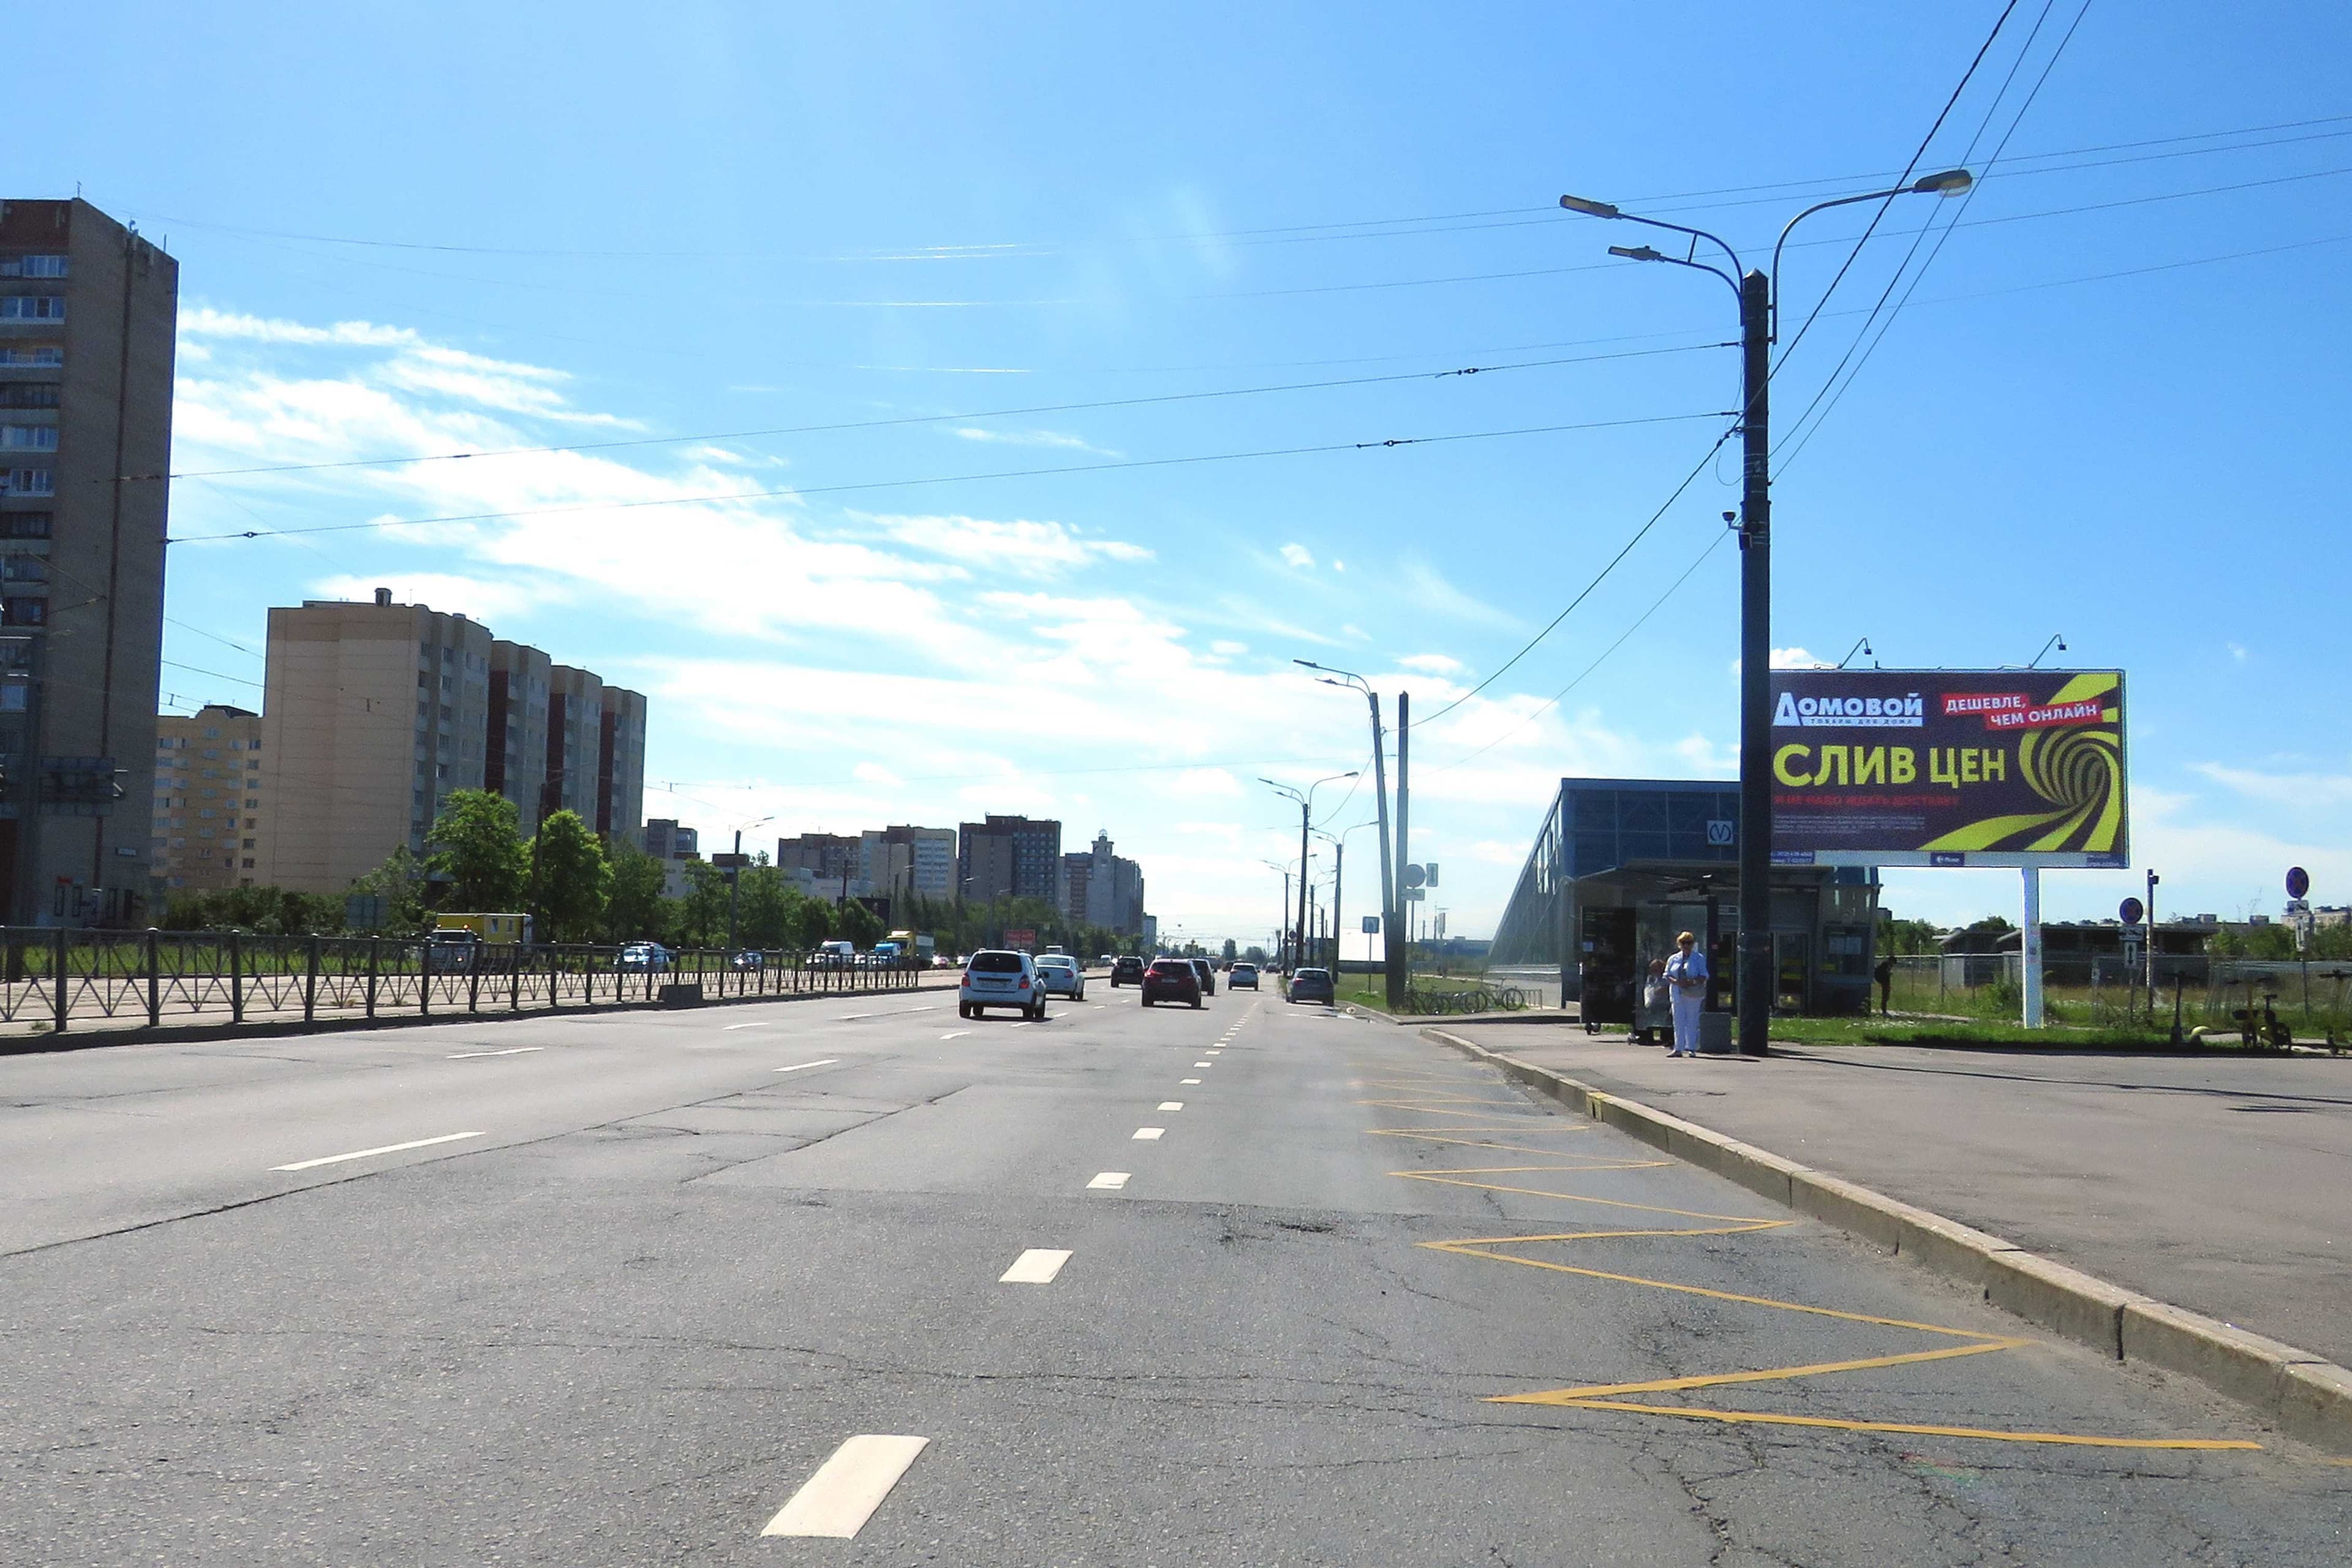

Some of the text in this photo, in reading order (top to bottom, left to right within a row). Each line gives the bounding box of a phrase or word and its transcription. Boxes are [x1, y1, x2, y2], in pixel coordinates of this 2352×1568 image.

[1772, 692, 1923, 726] ДОМОВОЙ
[1945, 696, 2026, 714] ДЕШЕВЛЕ,
[1991, 703, 2097, 726] ЧЕМ ОНЛАЙН
[1773, 744, 2006, 788] СЛИВ ЦЕН
